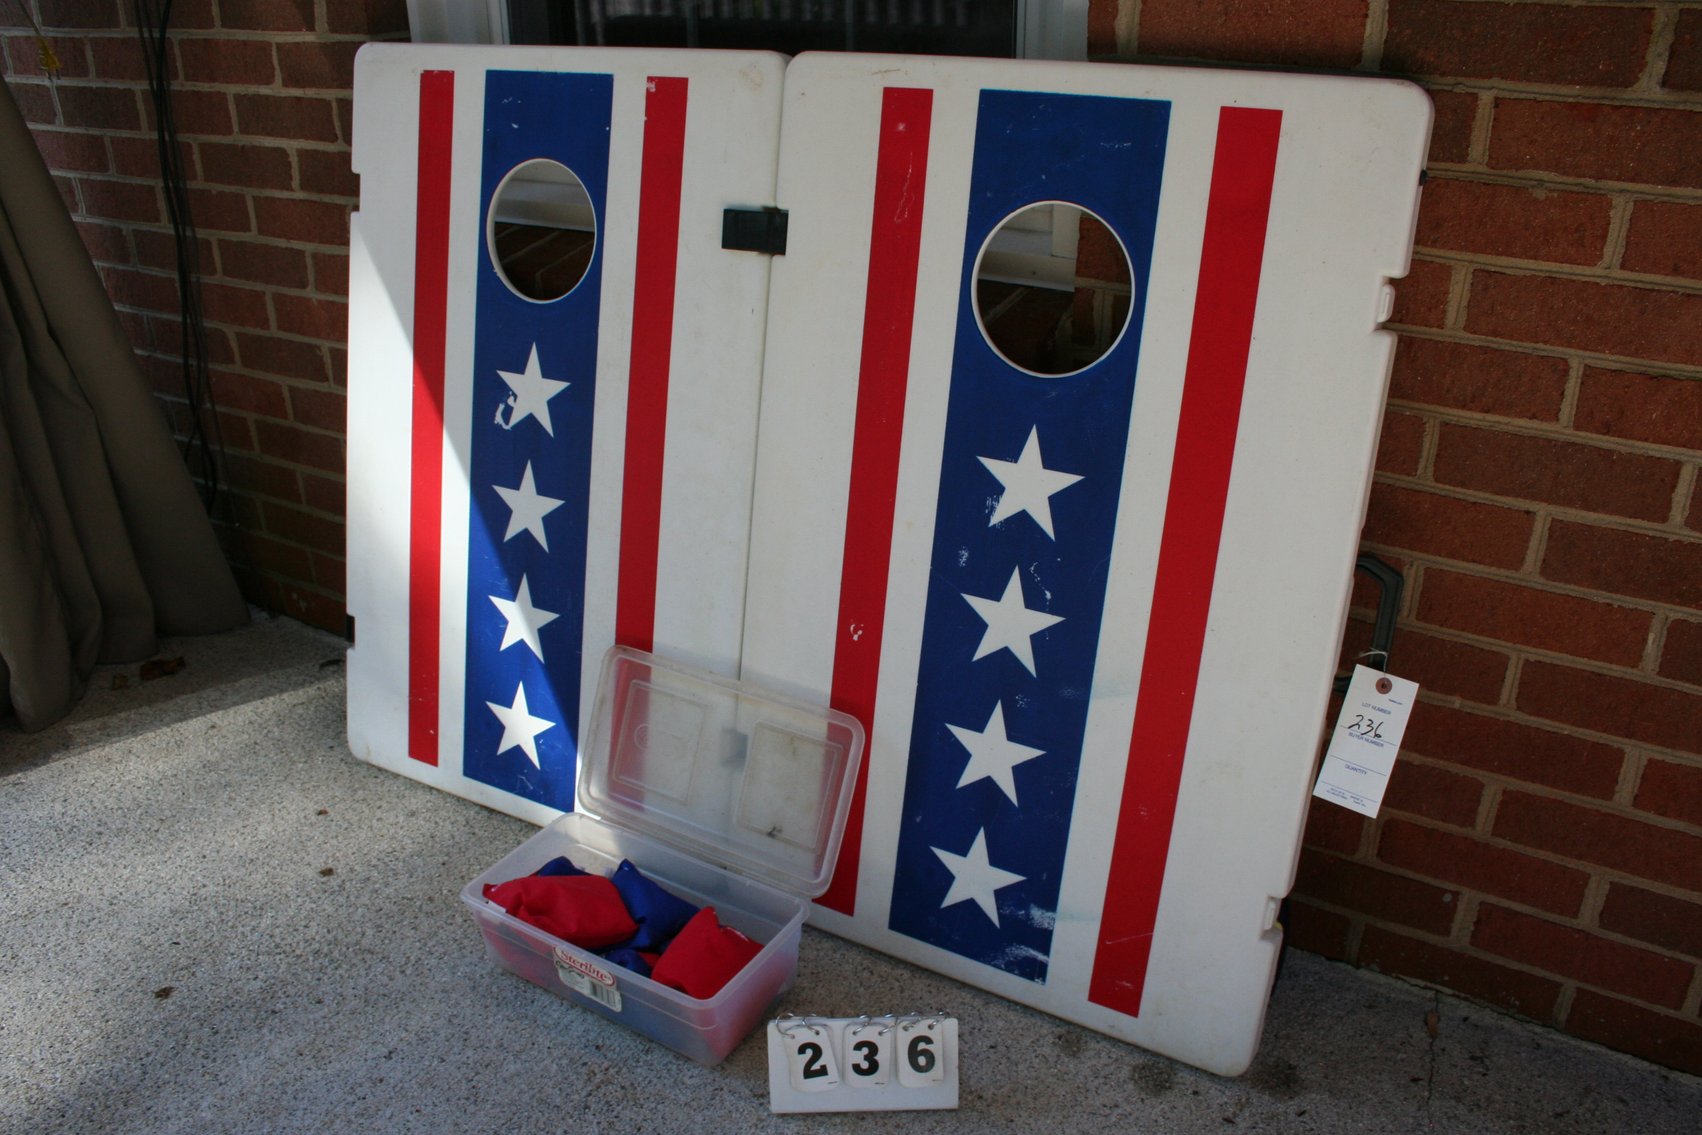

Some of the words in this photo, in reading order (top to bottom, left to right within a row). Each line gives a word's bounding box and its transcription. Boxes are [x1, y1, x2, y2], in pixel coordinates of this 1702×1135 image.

[1371, 705, 1391, 714] NUMBER
[1347, 714, 1383, 738] 236
[1364, 737, 1384, 747] NUMBER
[1345, 764, 1367, 775] QUANTITY
[560, 950, 607, 982] Sterilite
